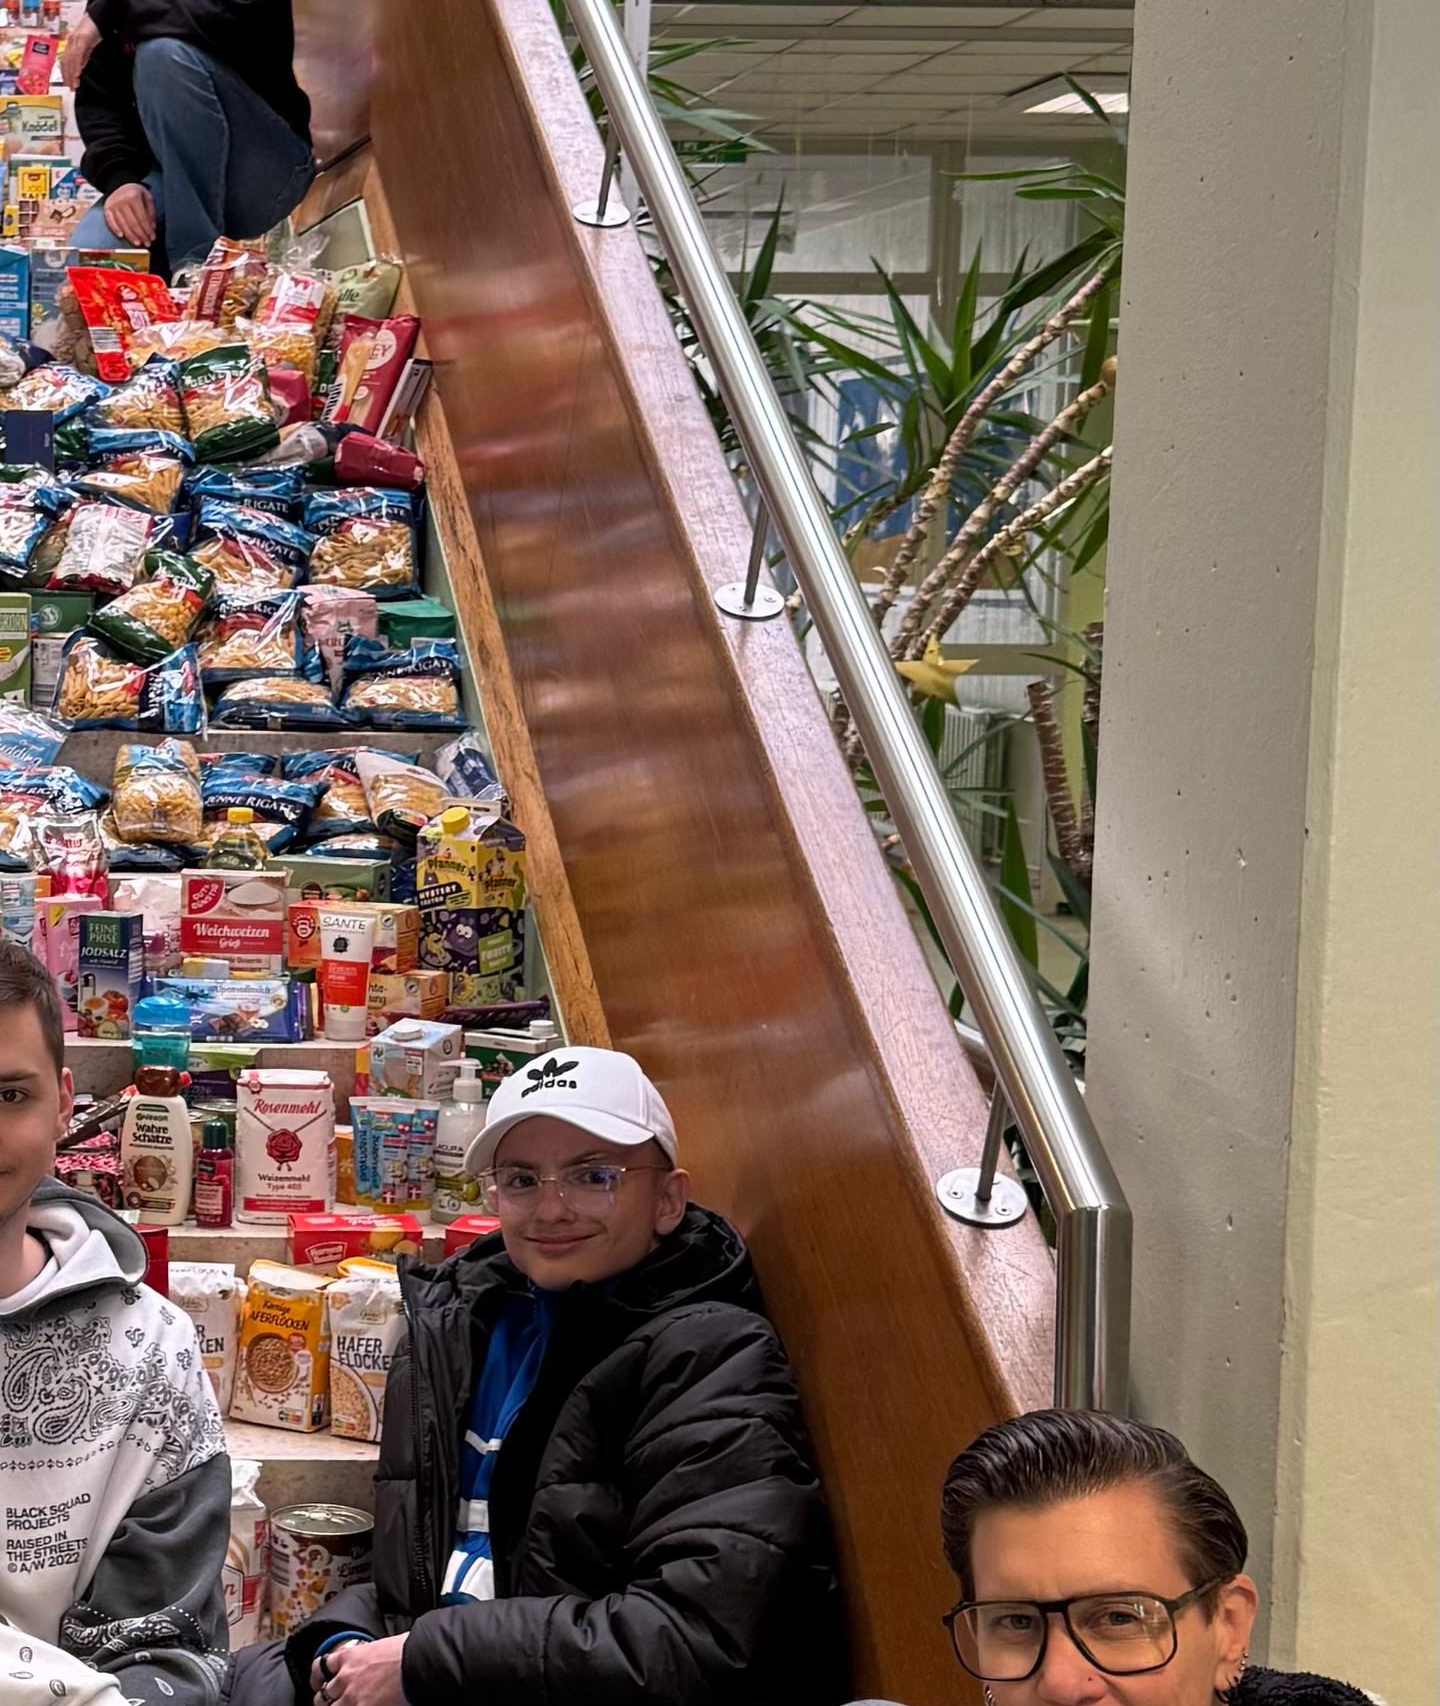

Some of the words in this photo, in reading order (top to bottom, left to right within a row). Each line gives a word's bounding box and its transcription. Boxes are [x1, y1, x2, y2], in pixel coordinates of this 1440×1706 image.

[243, 497, 289, 513] RIGATE
[193, 922, 270, 938] Weichweizen
[323, 916, 366, 930] SANTE
[89, 932, 119, 945] PRISE
[80, 946, 127, 960] JODSALZ
[521, 1079, 578, 1098] adidas
[253, 1098, 322, 1115] Rosenmehl
[136, 1122, 169, 1135] Wahre
[336, 1335, 383, 1353] HAFER
[339, 1351, 392, 1371] FLOCKE
[6, 1506, 48, 1519] BLACK
[49, 1492, 91, 1514] SQUAD
[6, 1512, 70, 1532] PROJECTS
[6, 1535, 51, 1550] RAISED
[53, 1530, 68, 1541] IN
[6, 1548, 33, 1563] THE
[33, 1537, 88, 1558] STREETS
[19, 1557, 48, 1573] A/W
[48, 1551, 81, 1568] 2022
